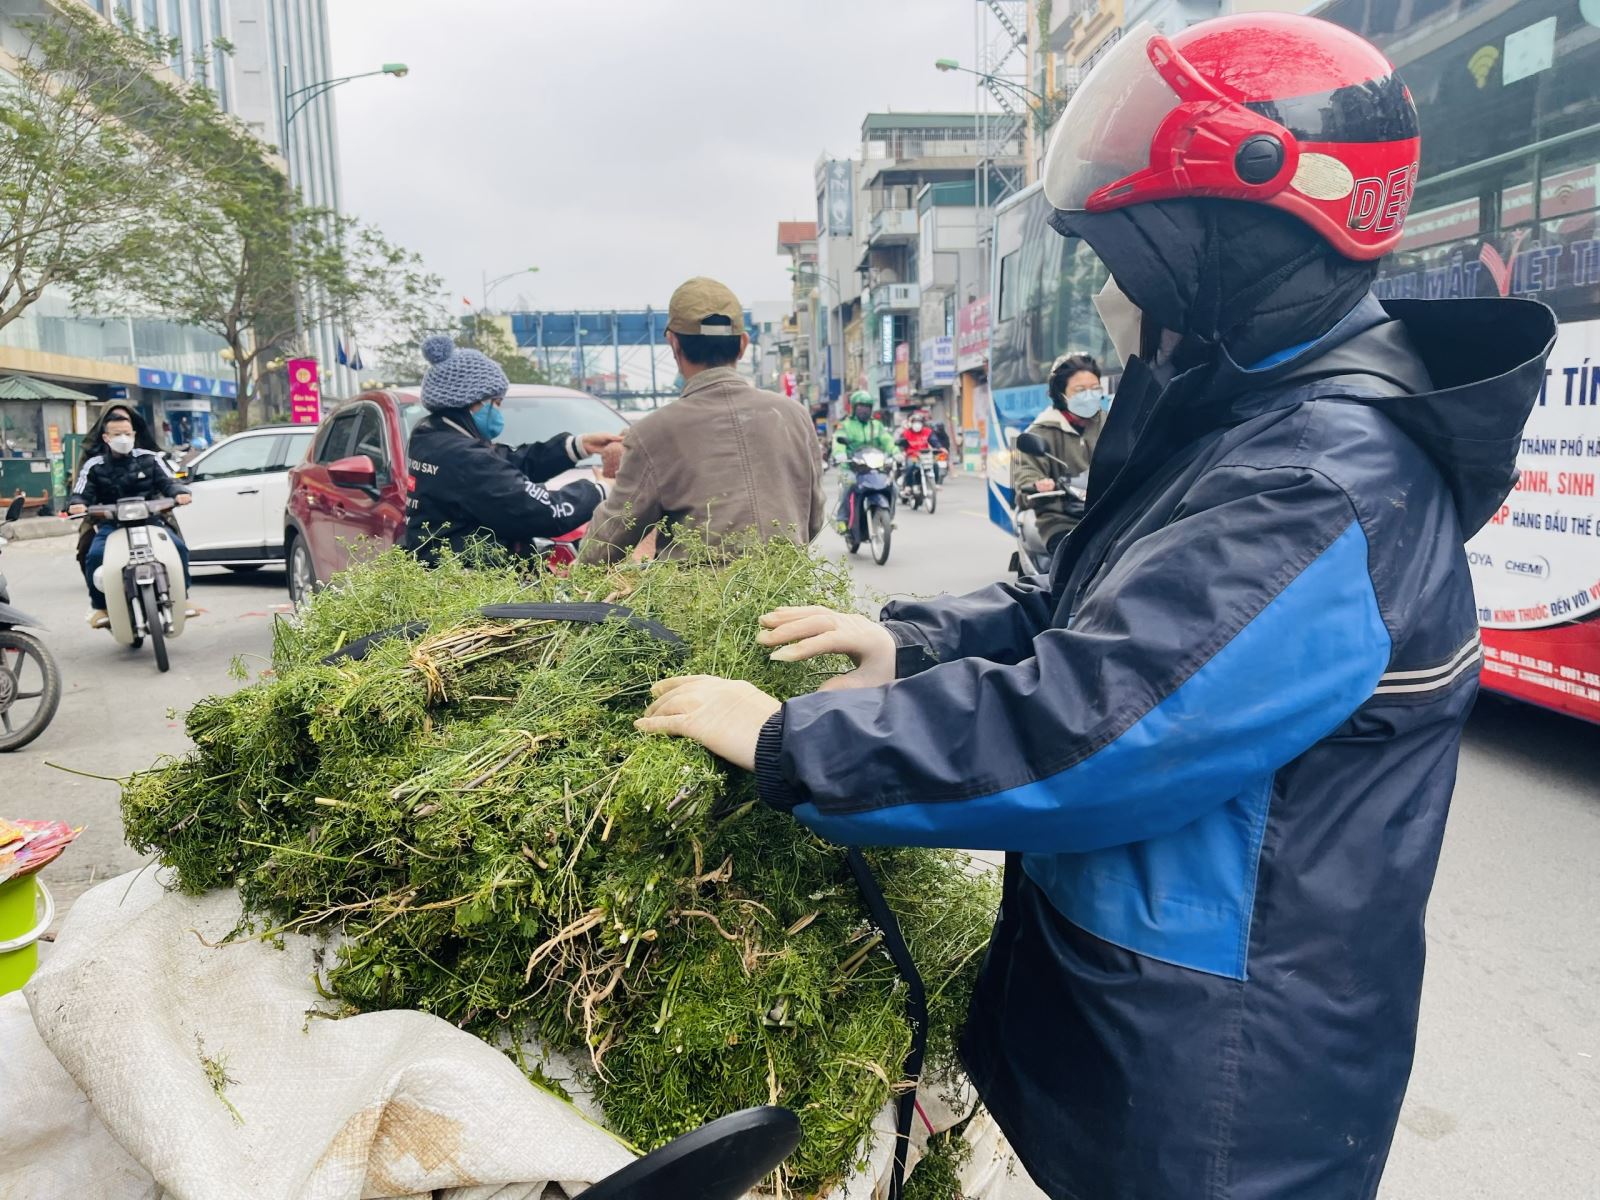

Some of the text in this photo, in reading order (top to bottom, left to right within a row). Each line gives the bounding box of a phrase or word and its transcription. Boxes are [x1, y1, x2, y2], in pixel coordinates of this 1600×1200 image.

[1480, 226, 1563, 300] VIỆT
[421, 462, 439, 475] SAY
[1557, 472, 1595, 496] SINH
[1512, 508, 1542, 530] HÀNG
[1466, 551, 1544, 576] OYA CHEMI
